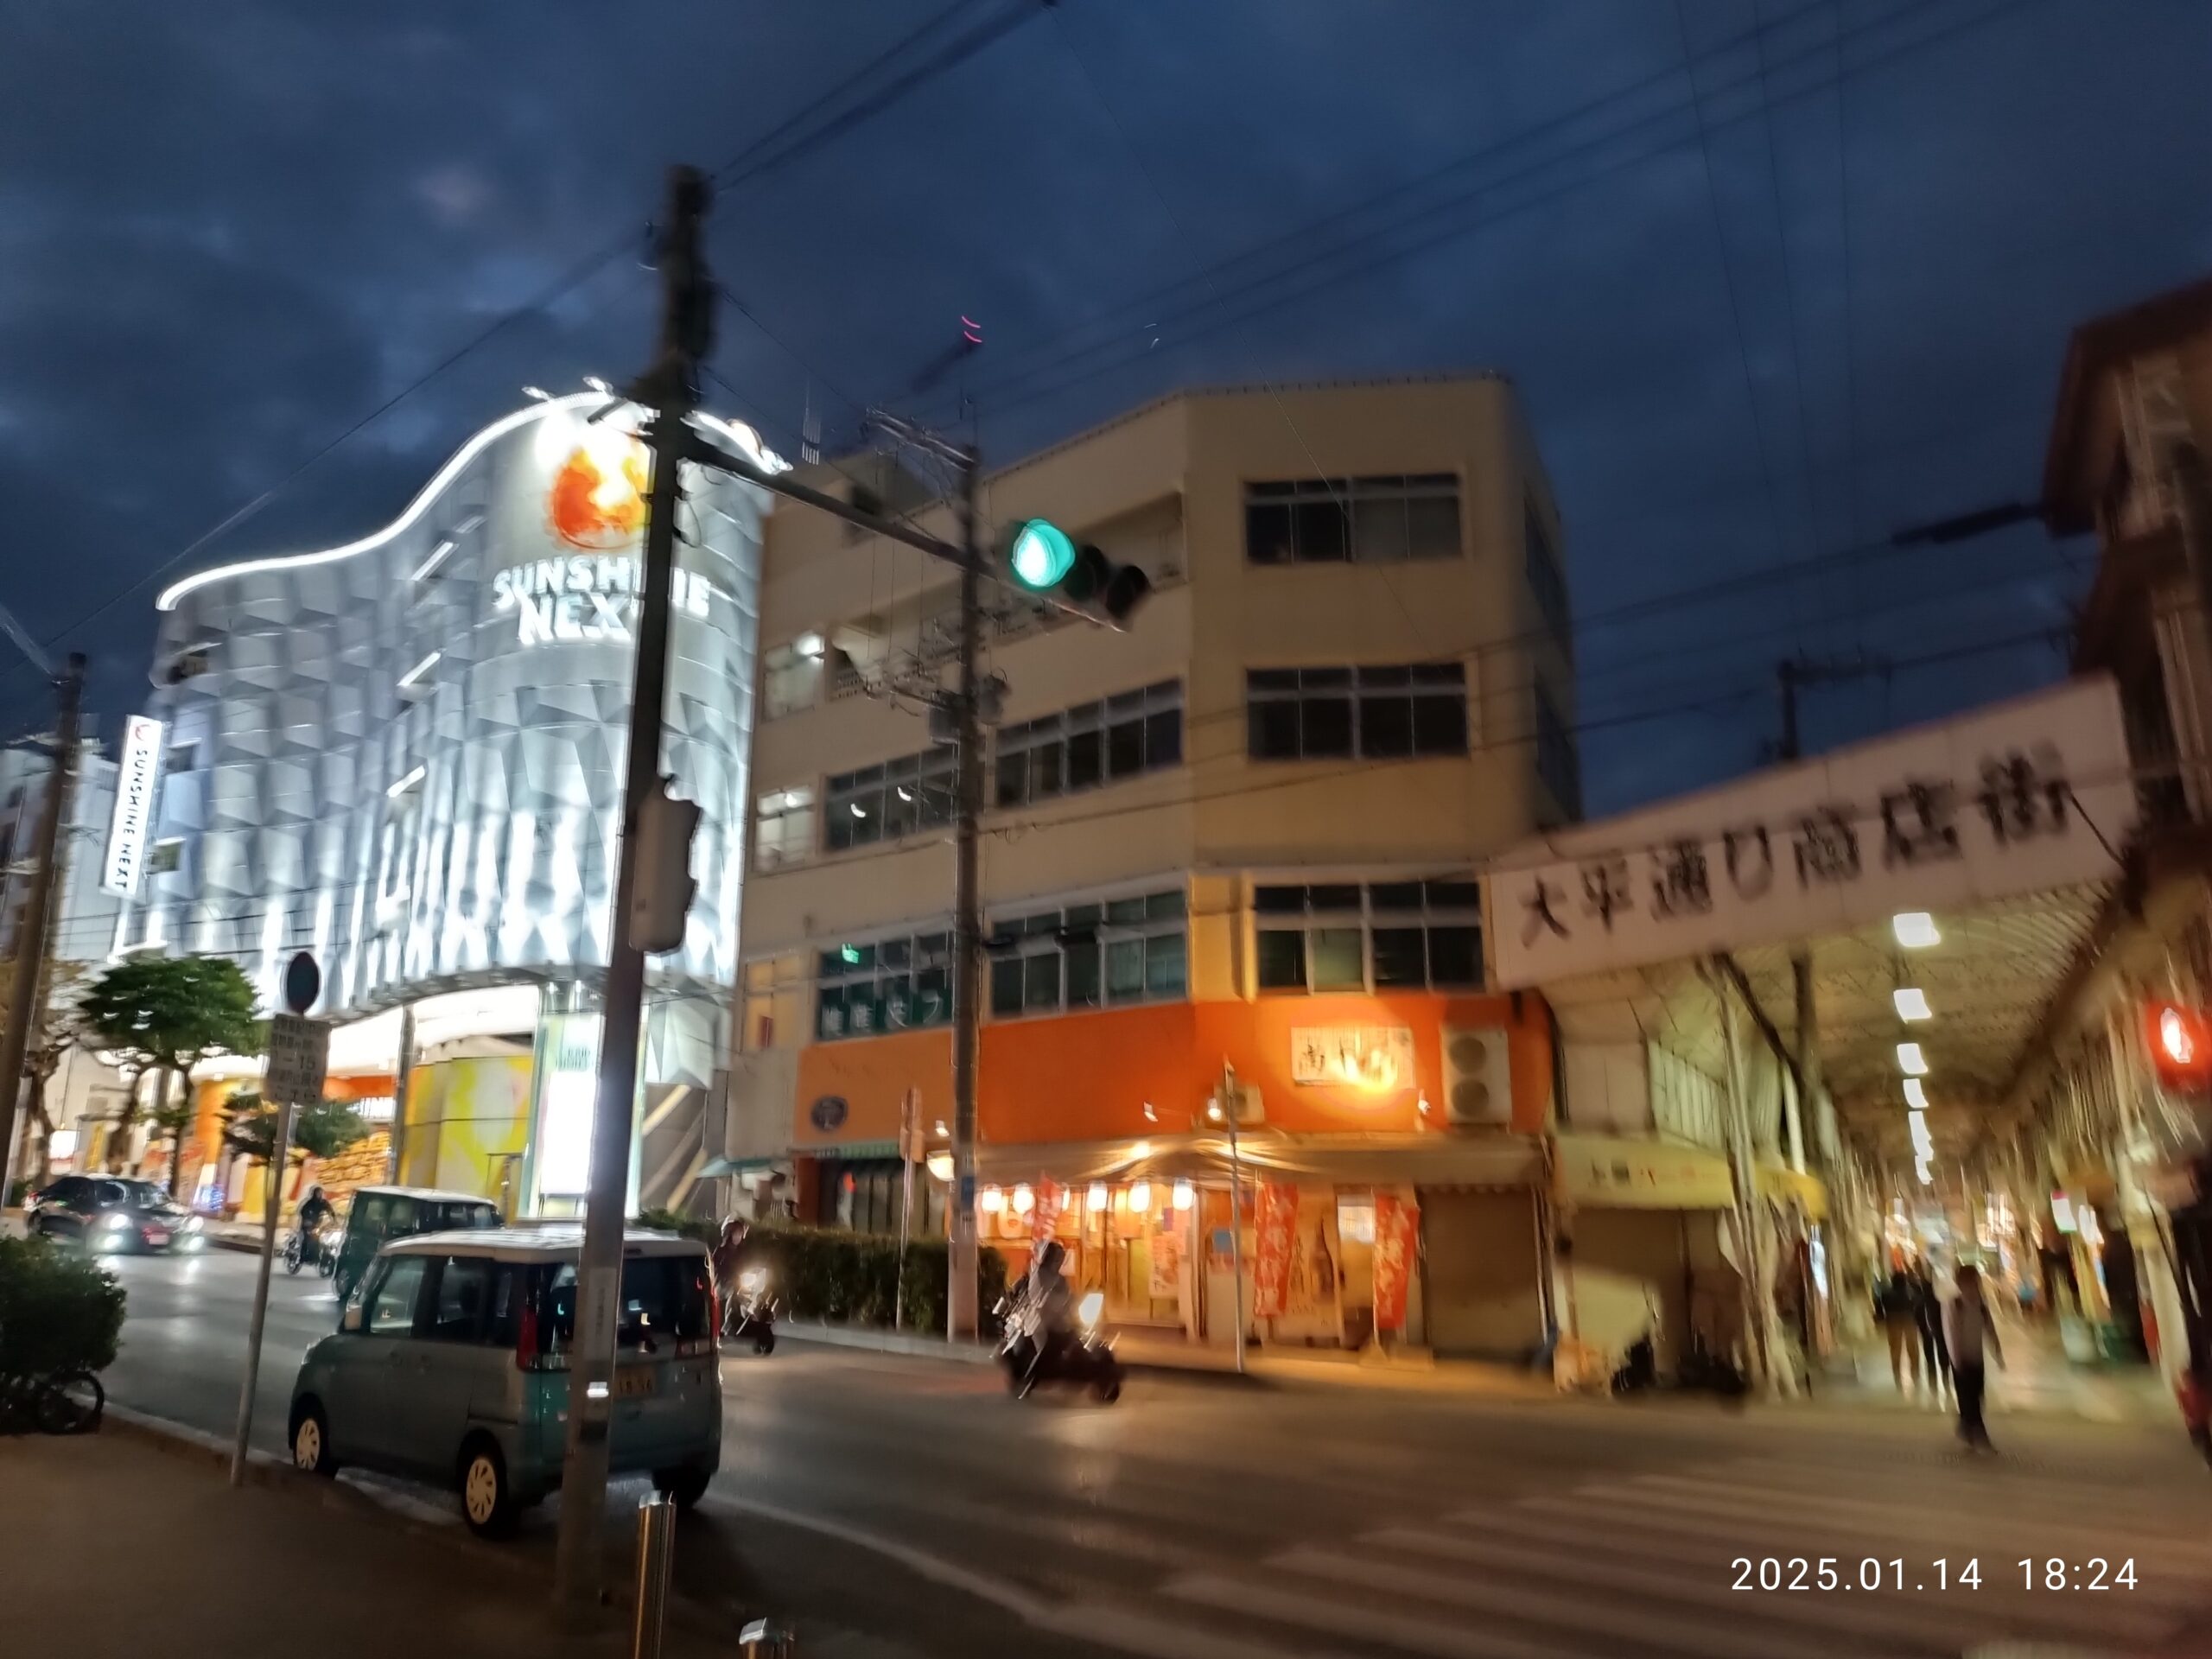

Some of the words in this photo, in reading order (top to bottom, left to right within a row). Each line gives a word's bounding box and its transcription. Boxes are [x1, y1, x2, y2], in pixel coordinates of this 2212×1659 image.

[518, 591, 641, 645] NEX
[123, 749, 148, 836] SUNSHINE
[114, 843, 131, 888] NEXT
